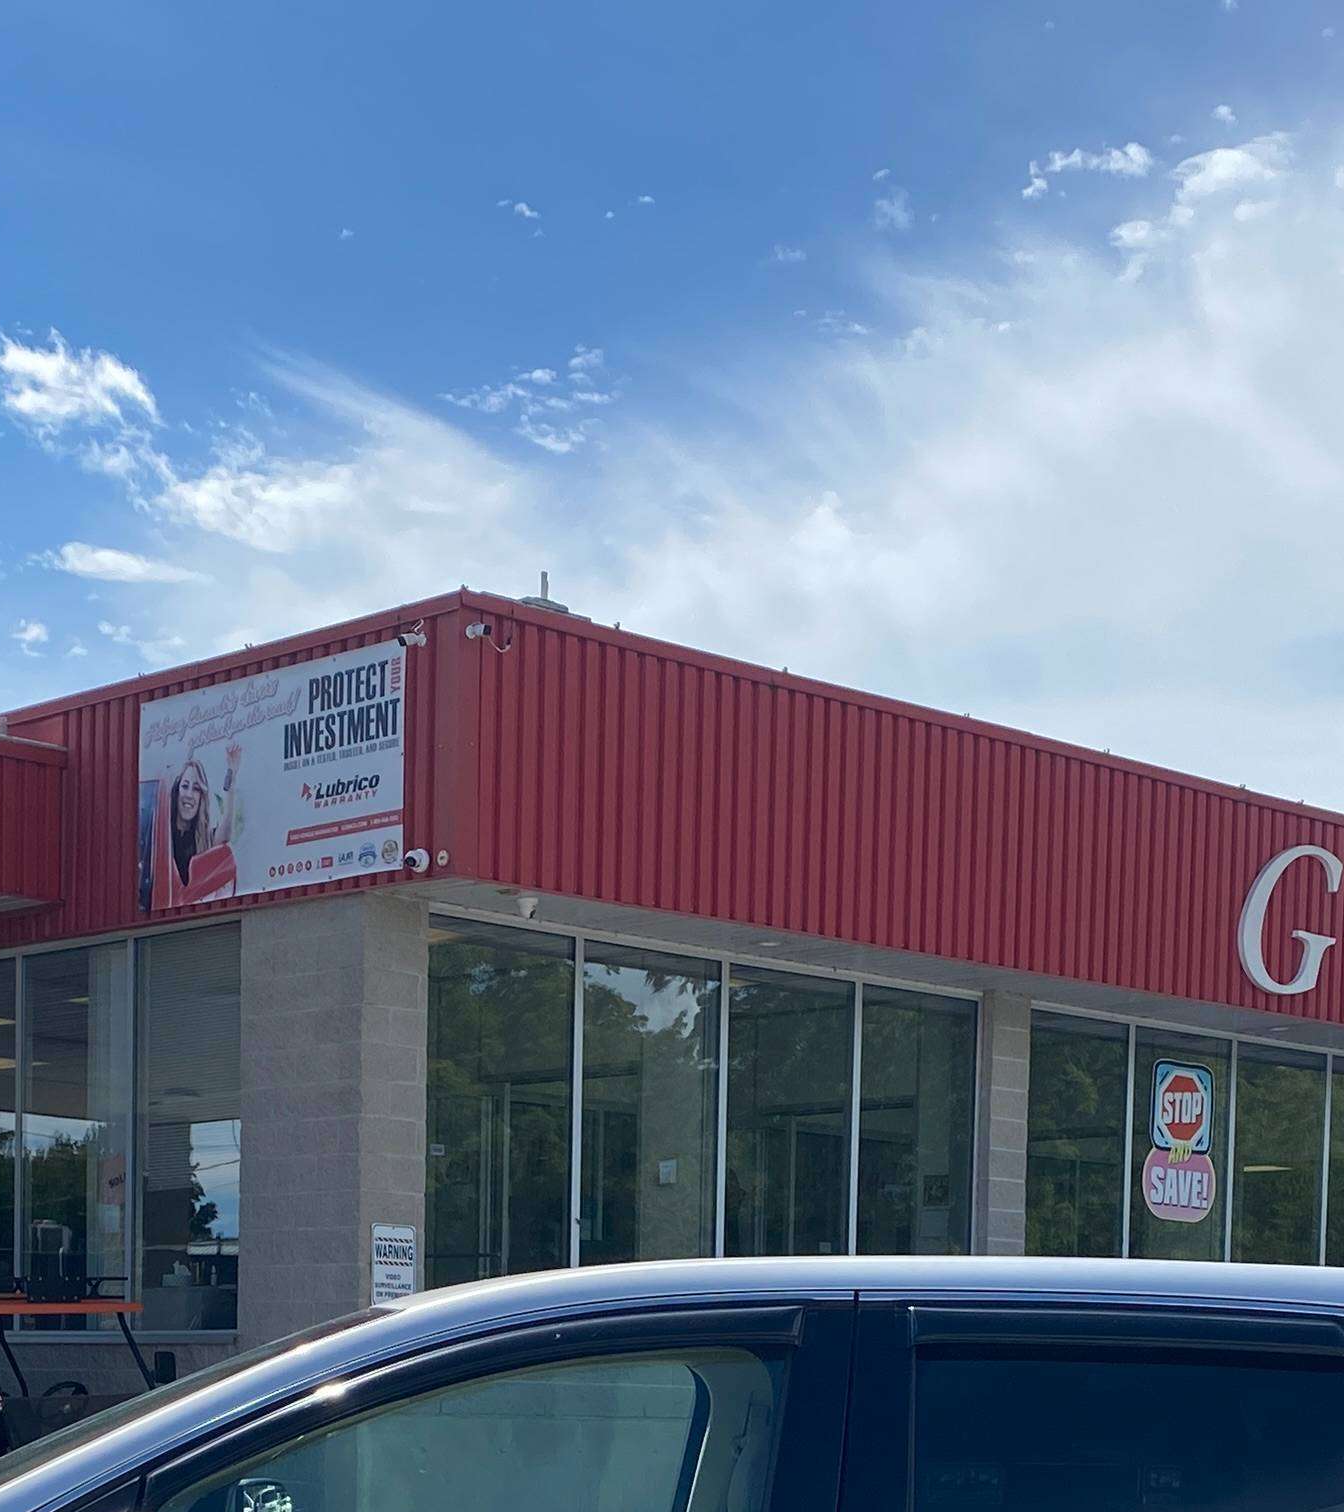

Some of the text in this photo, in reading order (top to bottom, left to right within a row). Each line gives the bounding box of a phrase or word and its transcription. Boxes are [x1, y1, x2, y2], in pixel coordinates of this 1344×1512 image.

[309, 660, 388, 714] PROTECT
[391, 656, 400, 694] YOUR
[284, 698, 400, 759] INVESTMENT
[366, 743, 376, 754] AND
[314, 789, 378, 808] WARRANTY
[315, 774, 380, 800] Lubrico
[1163, 1092, 1203, 1124] STOP
[1168, 1144, 1192, 1164] AND
[1150, 1166, 1209, 1209] SAVE!
[375, 1244, 413, 1261] WARNING
[375, 1282, 411, 1291] SURVEILLANCE
